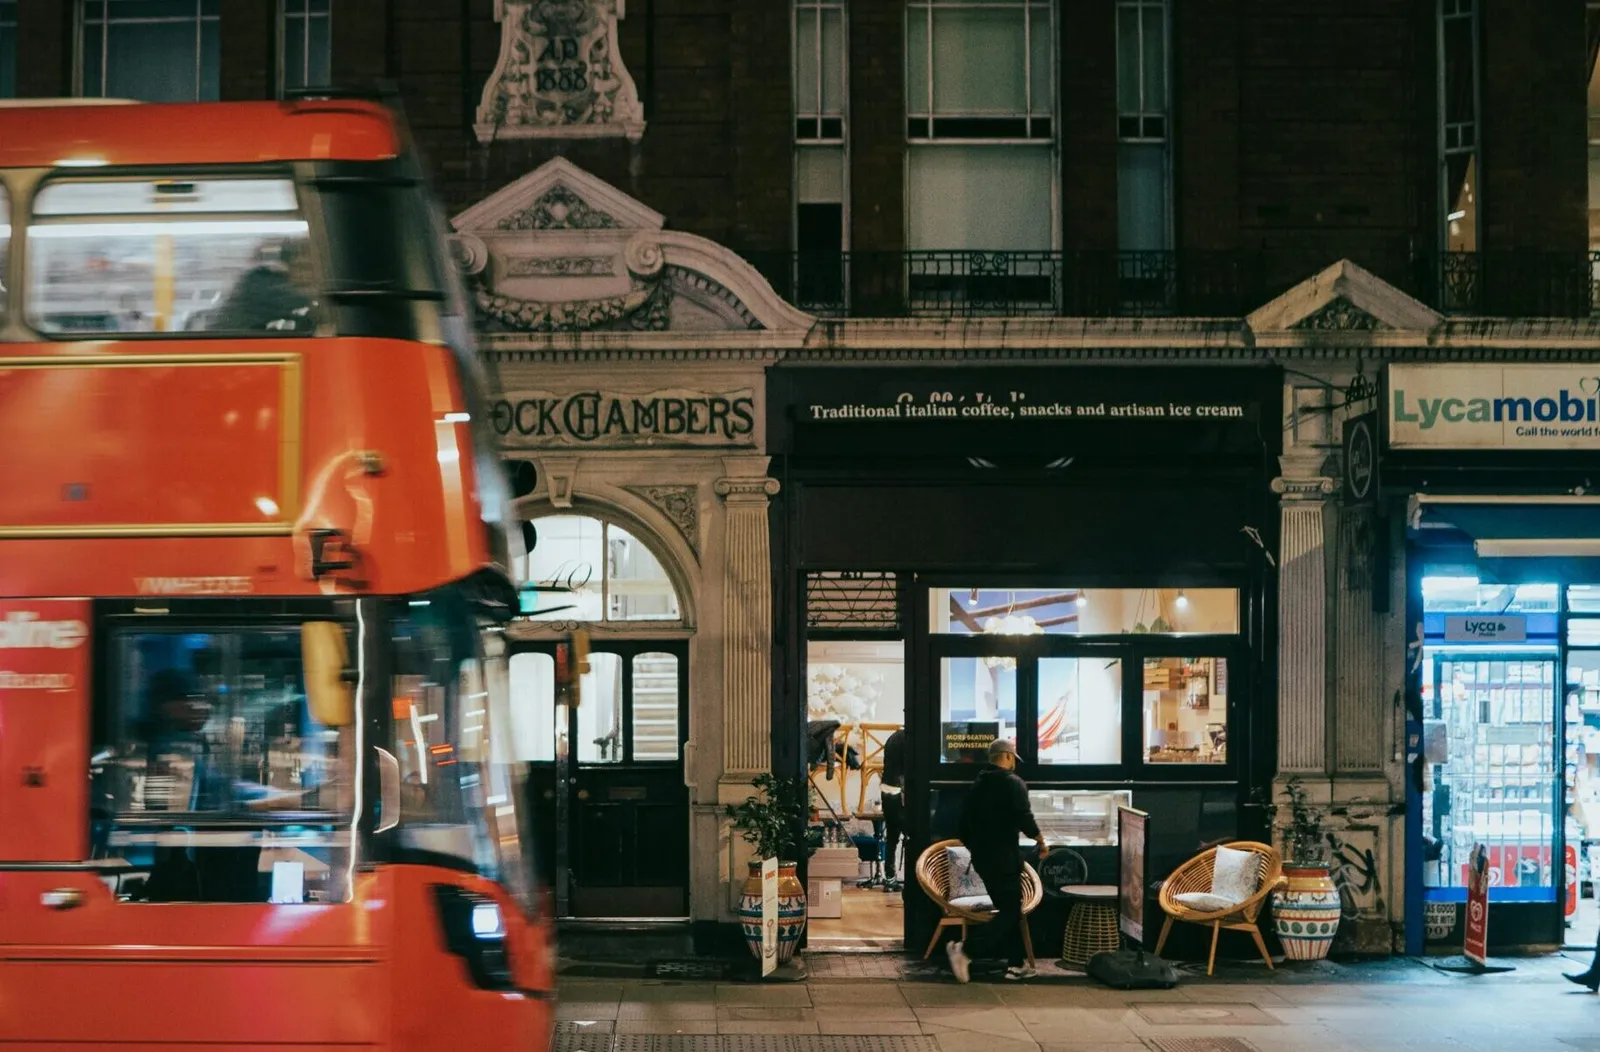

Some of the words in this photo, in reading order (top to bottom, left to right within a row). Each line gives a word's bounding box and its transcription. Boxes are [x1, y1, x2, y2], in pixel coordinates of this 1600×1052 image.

[534, 61, 588, 92] 1888
[563, 390, 754, 441] CHAMBERS
[810, 404, 900, 419] Traditional
[905, 403, 957, 418] italian
[961, 402, 1015, 419] coffee,
[1020, 403, 1072, 417] snacks
[1076, 403, 1105, 417] and
[1110, 403, 1164, 417] artisan
[1169, 403, 1191, 416] ice
[1196, 405, 1243, 417] cream
[1394, 390, 1600, 430] Lycamobi
[1516, 426, 1537, 437] Call
[1540, 426, 1558, 437] the
[1561, 426, 1592, 437] world
[1464, 619, 1496, 634] Lyca
